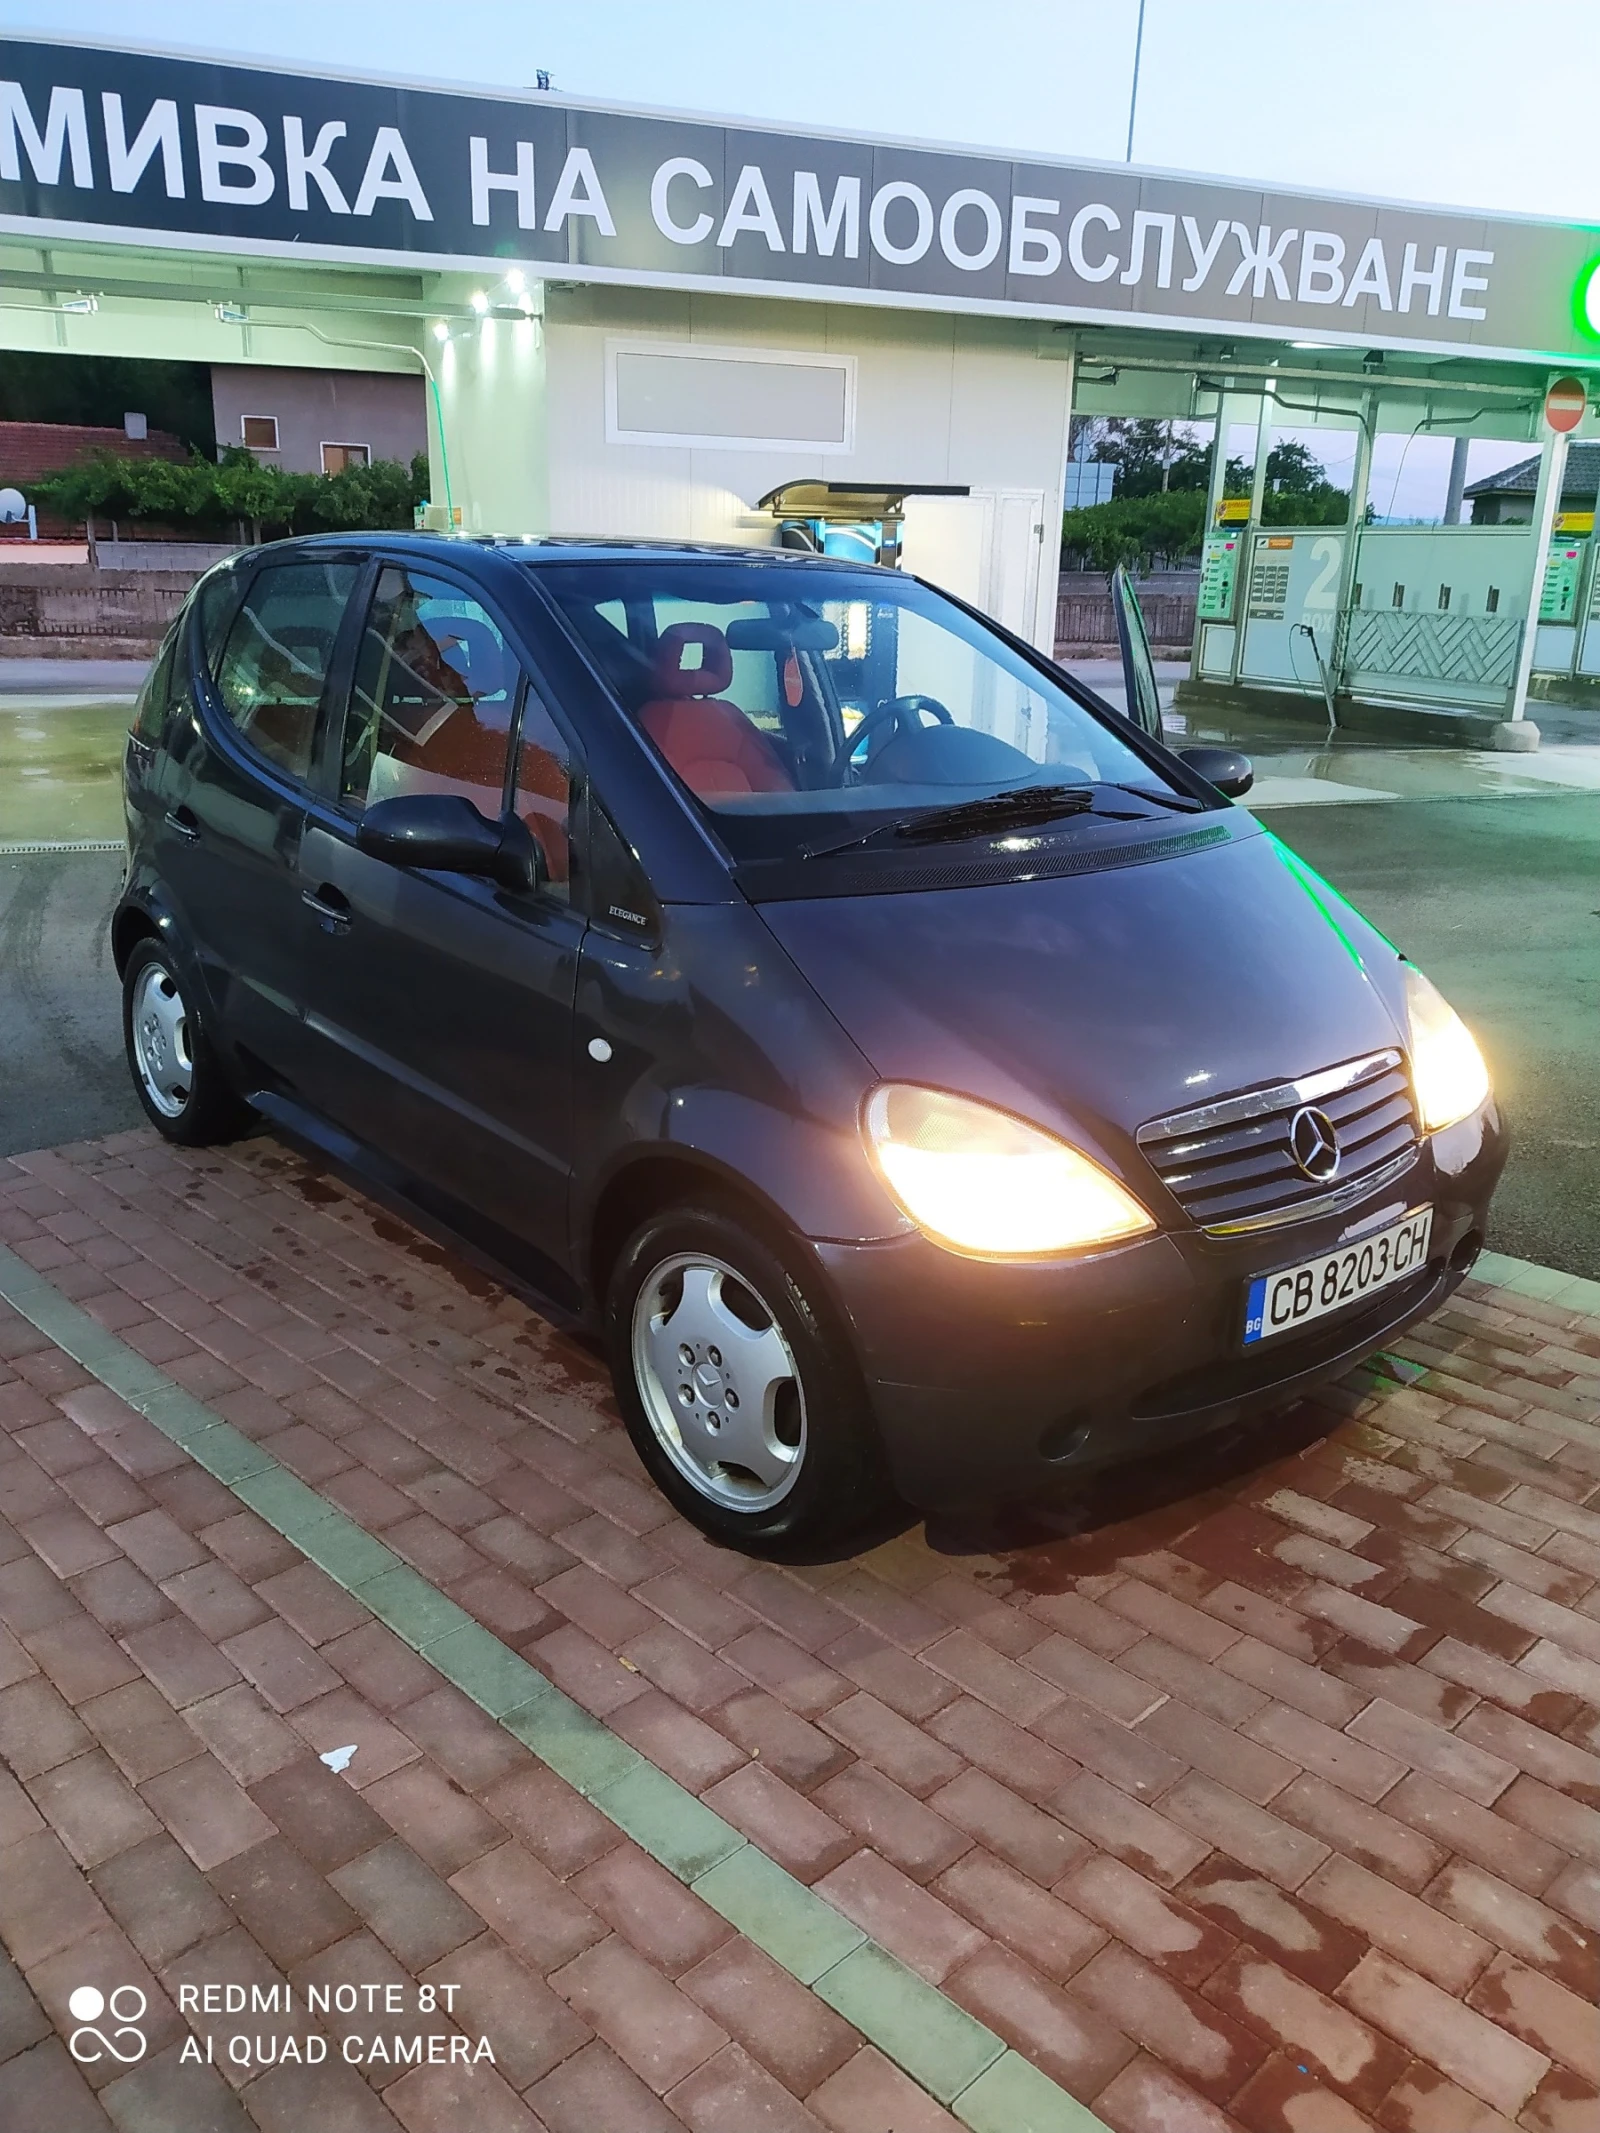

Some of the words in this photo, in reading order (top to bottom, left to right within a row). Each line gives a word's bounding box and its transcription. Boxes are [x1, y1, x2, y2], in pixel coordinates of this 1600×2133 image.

[0, 80, 433, 221] МИВКА
[469, 136, 616, 237] НА
[649, 157, 1495, 321] САМООБСЛУЖВАНЕ
[1303, 537, 1342, 610] 2
[608, 905, 647, 926] ELEGANCE
[1270, 1269, 1314, 1326] CB
[1320, 1237, 1390, 1306] 8203
[1245, 1317, 1261, 1334] BG
